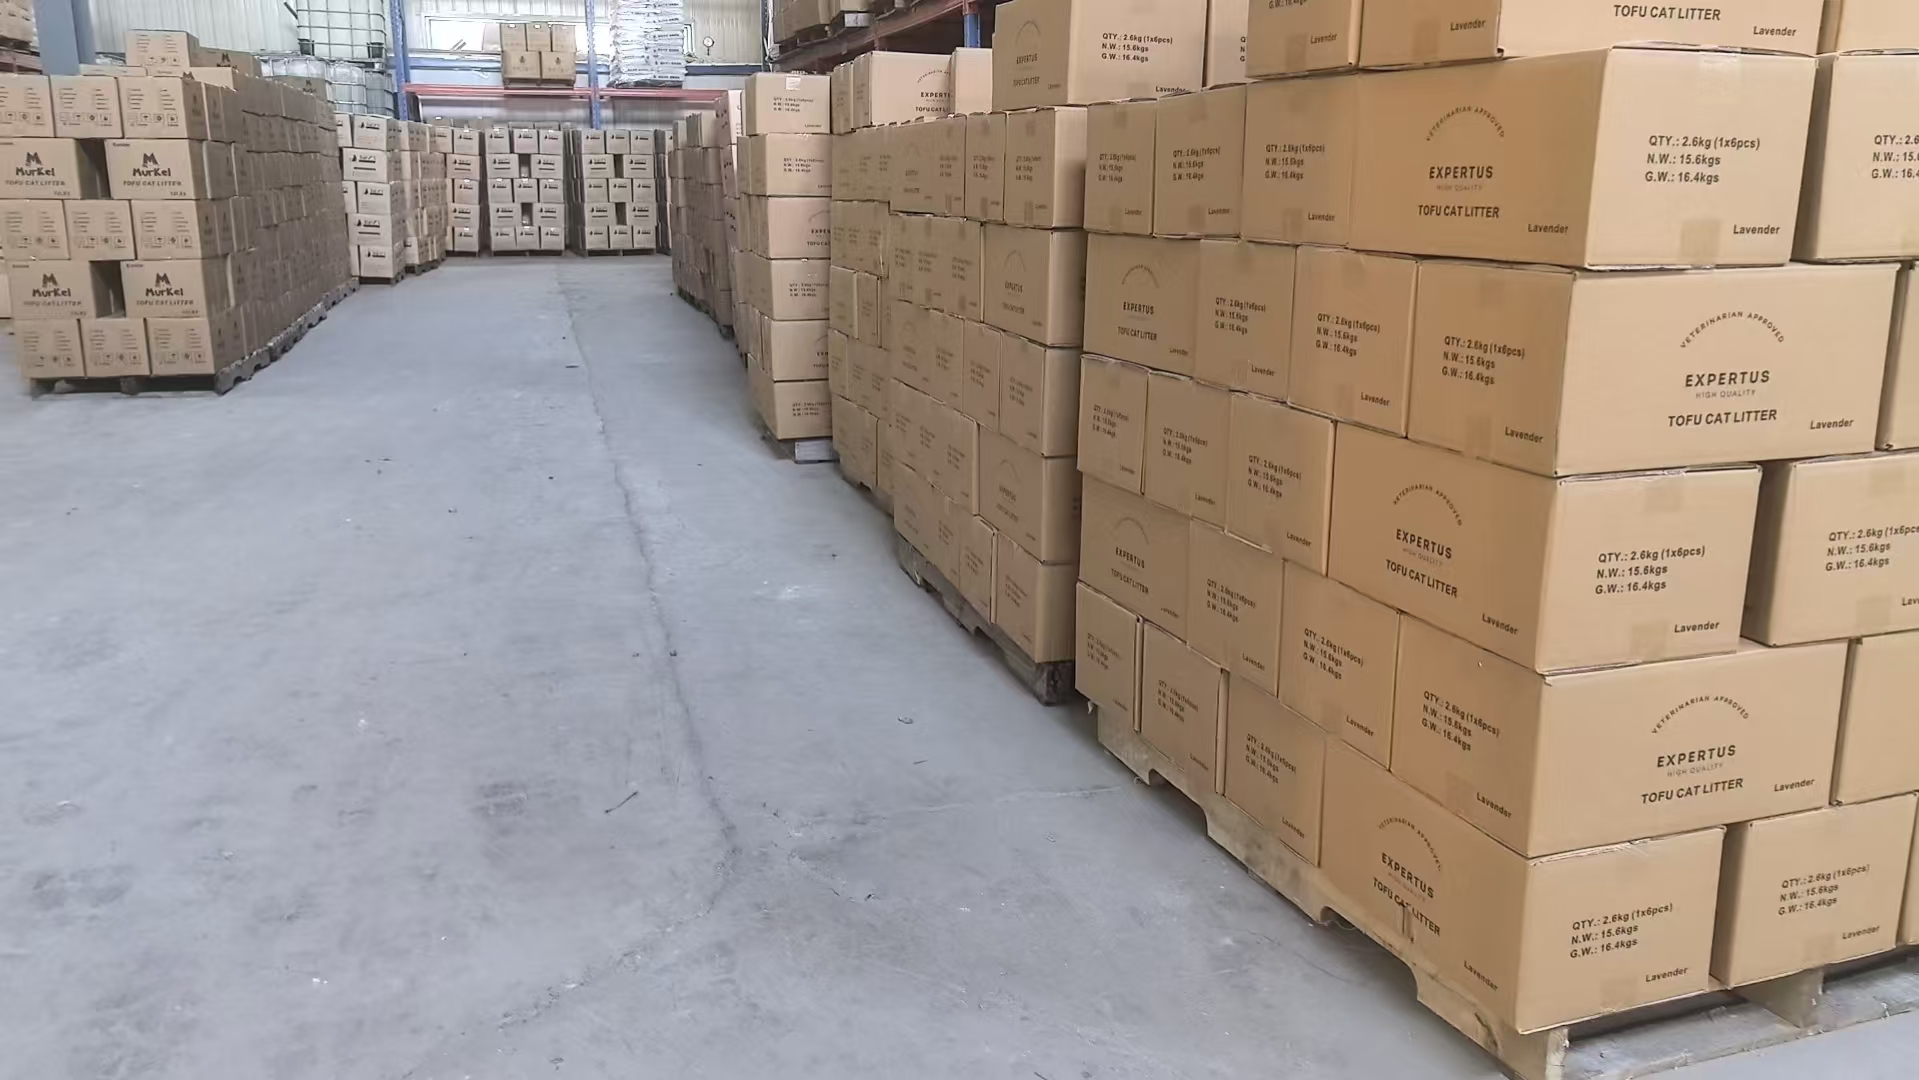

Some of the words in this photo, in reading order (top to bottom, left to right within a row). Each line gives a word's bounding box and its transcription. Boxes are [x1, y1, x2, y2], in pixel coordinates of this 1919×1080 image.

[1613, 4, 1648, 17] TOFU
[1650, 6, 1676, 18] CAT
[1677, 7, 1721, 20] LITTER
[1450, 19, 1486, 31] Lavender
[1753, 26, 1797, 36] Lavender
[1102, 32, 1122, 40] QTY.:
[1123, 33, 1143, 43] 2.6kg
[1143, 35, 1173, 44] (1x6pcs)
[1310, 33, 1338, 44] Lavender
[1101, 42, 1121, 50] N.W.:
[1122, 44, 1149, 53] 15.6kgs
[1122, 53, 1149, 63] 16.4kgs
[1649, 135, 1680, 146] QTY.:
[1681, 136, 1712, 150] 2.6kg
[1713, 137, 1761, 150] (1x6pcs)
[1874, 134, 1903, 145] QTY.:
[1904, 134, 1919, 145] 2.6
[1646, 153, 1677, 164] N.W.:
[1679, 153, 1721, 167] 15.6kgs
[1872, 151, 1900, 162] N.W.:
[1429, 165, 1494, 179] EXPERTUS
[1644, 170, 1675, 182] G.W.:
[1678, 171, 1720, 185] 16.4kgs
[1871, 168, 1899, 179] G.W.:
[1901, 168, 1919, 178] 16.4
[1418, 204, 1442, 216] TOFU
[1443, 205, 1464, 216] CAT
[1464, 206, 1500, 218] LITTER
[1527, 224, 1569, 233] Lavender
[1733, 224, 1781, 234] Lavender
[1681, 311, 1743, 348] VETERINARIAN
[1747, 313, 1784, 343] APPROVED
[1444, 335, 1466, 347] QTY.:
[1466, 339, 1489, 353] 2.6kg
[1489, 343, 1525, 358] (1x6pcs)
[1443, 351, 1464, 363] N.W.:
[1465, 354, 1495, 369] 15.6kgs
[1441, 365, 1463, 378] G.W.:
[1464, 370, 1495, 385] 16.4kgs
[1685, 370, 1770, 387] EXPERTUS
[1360, 392, 1390, 406] Lavender
[1695, 390, 1718, 398] HIGH
[1719, 388, 1756, 398] QUALITY
[1668, 414, 1703, 426] TOFU
[1705, 411, 1732, 424] CAT
[1733, 409, 1777, 422] LITTER
[1810, 418, 1854, 429] Lavender
[1505, 427, 1544, 442] Lavender
[1828, 530, 1856, 541] QTY.:
[1857, 528, 1884, 539] 2.6kg
[1884, 525, 1919, 537] (1x6pcs
[1396, 529, 1452, 558] EXPERTUS
[1827, 546, 1853, 556] N.W.:
[1855, 542, 1891, 553] 15.6kgs
[1598, 552, 1628, 563] QTY.:
[1630, 550, 1659, 561] 2.6kg
[1661, 546, 1706, 559] (1x6pcs)
[1596, 567, 1626, 578] N.W.:
[1628, 565, 1668, 576] 15.6kgs
[1825, 560, 1852, 571] G.W.:
[1854, 557, 1890, 568] 16.4kgs
[1386, 559, 1408, 576] TOFU
[1408, 569, 1427, 583] CAT
[1427, 576, 1458, 597] LITTER
[1595, 583, 1624, 594] G.W.:
[1627, 580, 1667, 591] 16.4kgs
[1481, 613, 1518, 634] Lavender
[1674, 621, 1720, 633] Lavender
[1652, 696, 1709, 734] VETERINARIAN
[1714, 696, 1749, 720] APPROVED
[1346, 715, 1374, 736] Lavender
[1657, 745, 1736, 767] EXPERTUS
[1667, 768, 1688, 777] HIGH
[1689, 762, 1723, 774] QUALITY
[1641, 790, 1674, 803] TOFU
[1676, 785, 1701, 798] CAT
[1702, 778, 1744, 793] LITTER
[1773, 779, 1815, 791] Lavender
[1476, 792, 1512, 817] Lavender
[1381, 853, 1434, 898] EXPERTUS
[1781, 877, 1807, 888] QTY.:
[1807, 872, 1832, 883] 2.6kg
[1832, 864, 1870, 879] (1x6pcs)
[1780, 891, 1804, 901] N.W.:
[1806, 884, 1839, 896] 15.6kgs
[1374, 877, 1393, 899] TOFU
[1412, 908, 1441, 935] LITTER
[1778, 904, 1803, 915] G.W.:
[1804, 897, 1838, 909] 16.4kgs
[1572, 918, 1601, 930] QTY.:
[1602, 913, 1630, 924] 2.6kg
[1631, 903, 1673, 920] (1x6pcs)
[1571, 932, 1598, 944] N.W.:
[1601, 925, 1638, 938] 15.6kgs
[1842, 926, 1880, 939] Lavender
[1569, 946, 1598, 958] G.W.:
[1601, 938, 1638, 951] 16.4kgs
[1463, 960, 1498, 990] Lavender
[1645, 967, 1688, 982] Lavender
